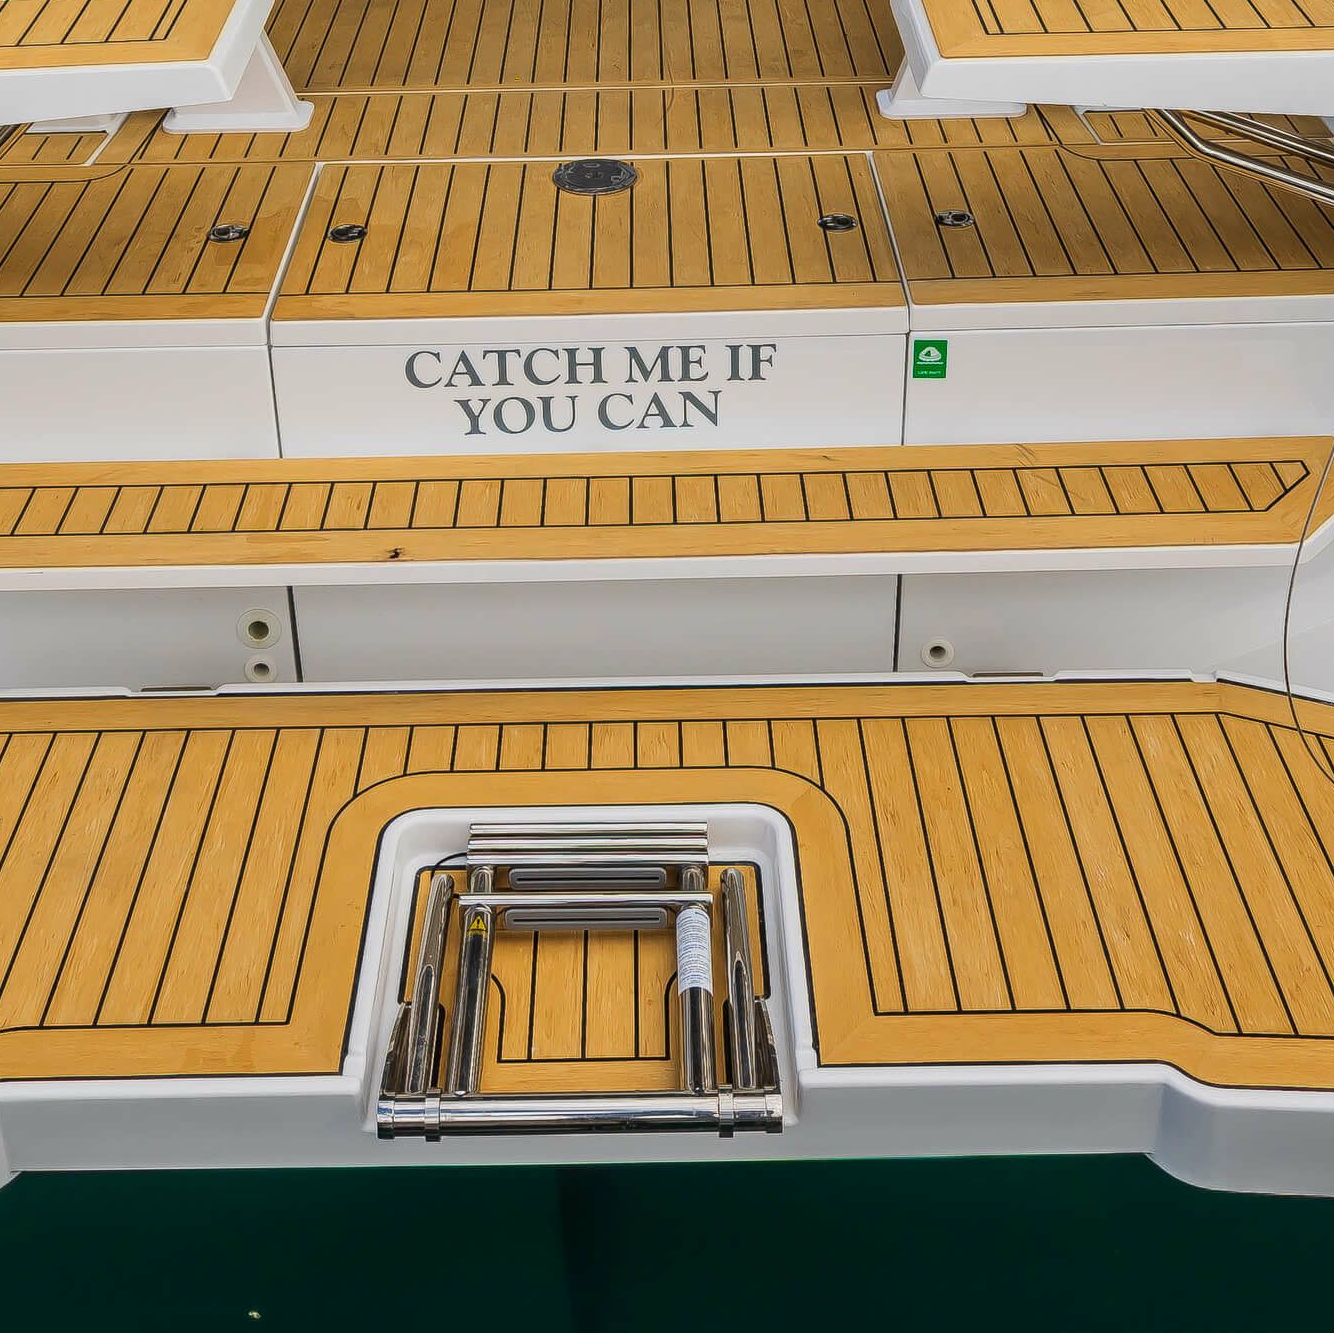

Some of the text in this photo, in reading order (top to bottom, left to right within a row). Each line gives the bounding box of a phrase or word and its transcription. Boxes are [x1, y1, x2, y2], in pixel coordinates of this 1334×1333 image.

[404, 342, 778, 389] CATCH ME IF
[454, 389, 723, 436] YOU CAN
